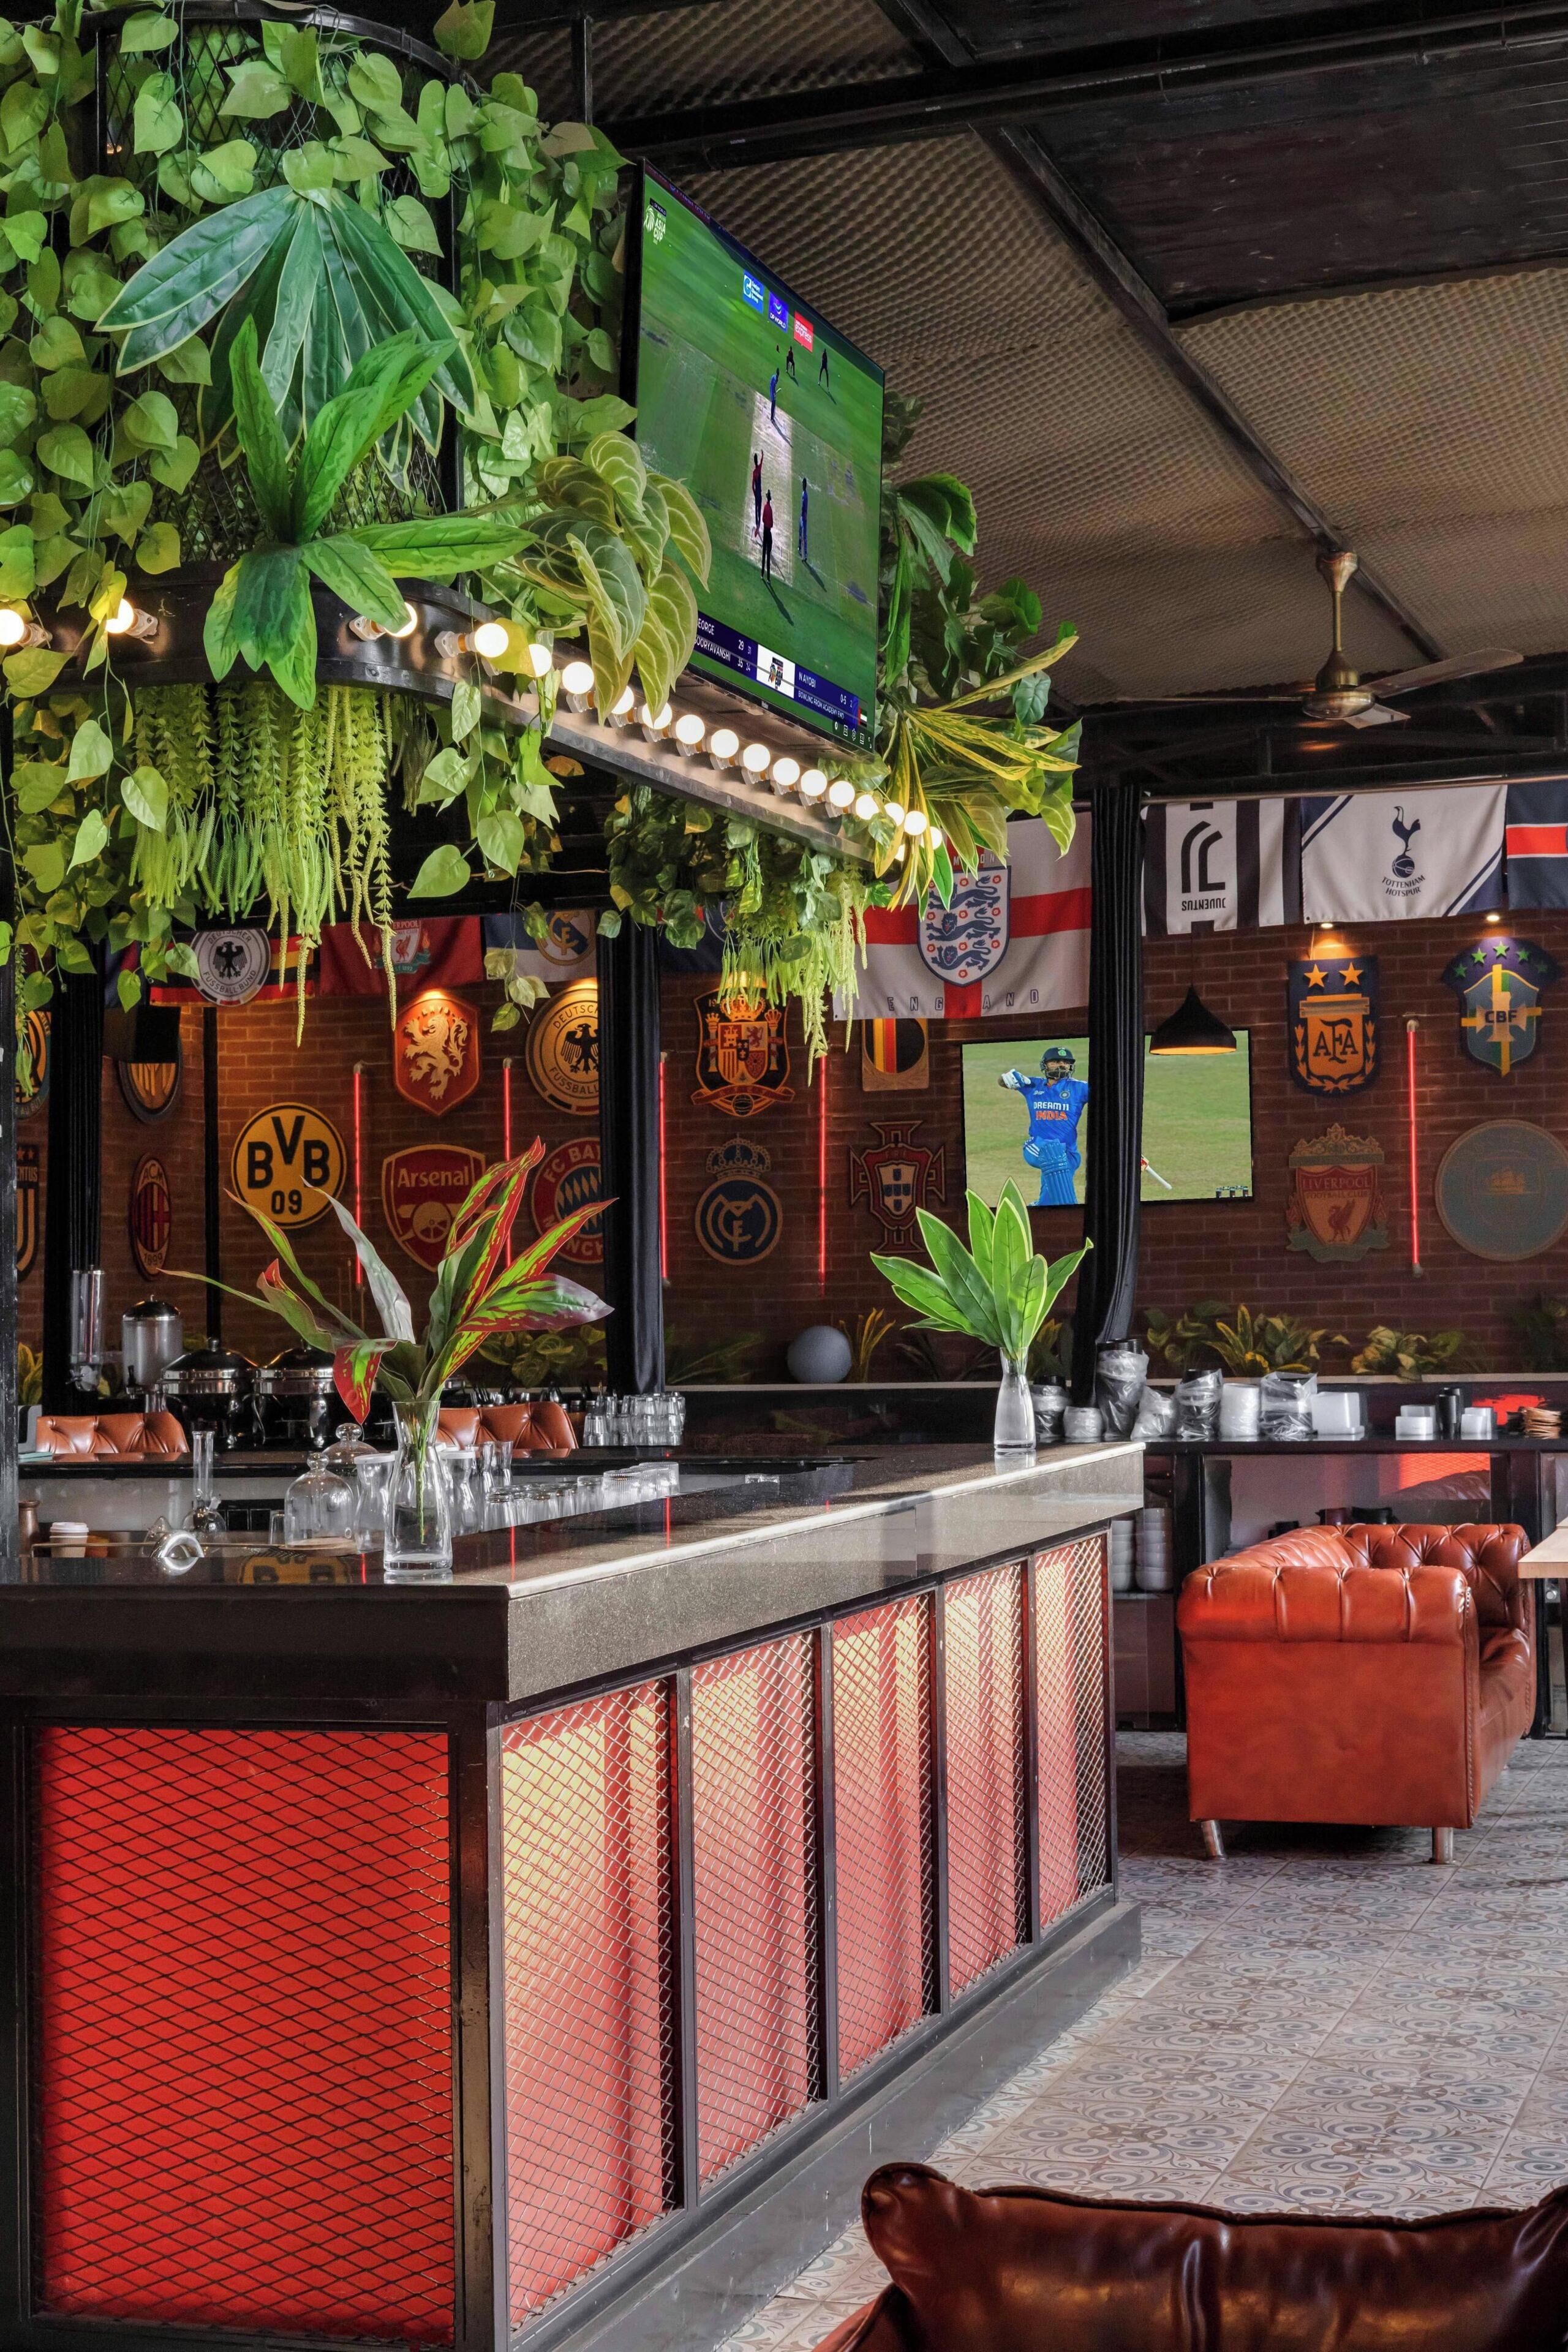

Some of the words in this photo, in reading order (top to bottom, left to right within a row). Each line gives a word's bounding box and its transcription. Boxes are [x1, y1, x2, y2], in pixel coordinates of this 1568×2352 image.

[655, 217, 666, 234] ASIA
[654, 227, 663, 242] CUP
[775, 315, 786, 329] WORLD
[795, 324, 812, 344] express
[697, 618, 715, 635] EORGE
[738, 639, 744, 650] 29
[799, 672, 802, 682] N
[803, 675, 816, 688] AYOBI
[798, 690, 813, 704] BOWLING
[813, 698, 823, 709] FROM
[823, 703, 837, 716] ACADEMY
[1382, 875, 1425, 888] TOTTENHAM
[1385, 886, 1421, 897] HOTSPUR
[1182, 897, 1226, 911] JUVENTUS
[392, 920, 419, 930] ERPOOL
[887, 989, 1039, 1011] ENGAND
[1485, 1009, 1518, 1023] CBF
[1313, 1018, 1359, 1064] AFA
[1036, 1110, 1068, 1121] INDIA
[247, 1115, 330, 1189] BVB
[141, 1164, 164, 1185] ACM
[398, 1166, 469, 1188] Arsenal
[543, 1158, 566, 1183] FC
[1303, 1176, 1370, 1189] LIVERPOOL
[271, 1189, 303, 1215] 09
[144, 1253, 162, 1266] 1899
